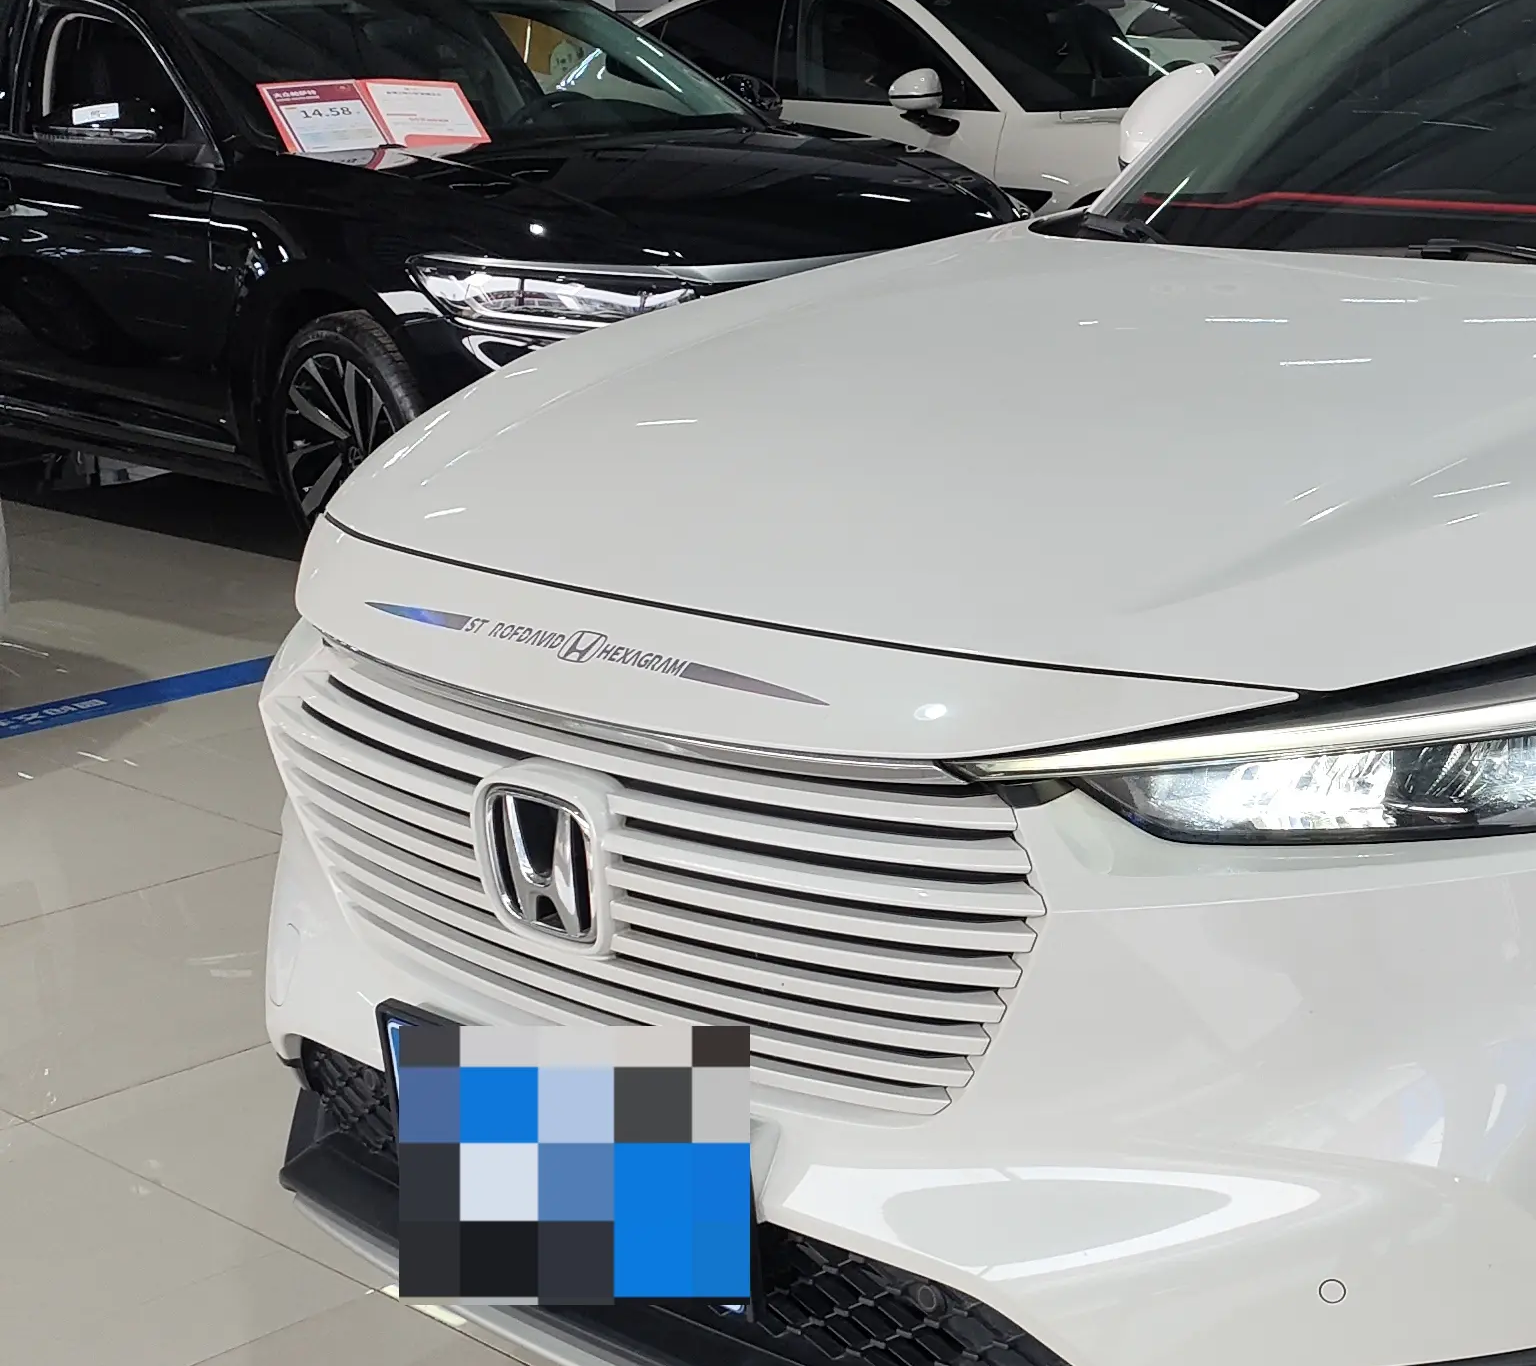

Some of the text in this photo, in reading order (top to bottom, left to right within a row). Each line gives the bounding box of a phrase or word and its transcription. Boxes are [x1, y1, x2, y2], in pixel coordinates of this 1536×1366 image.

[301, 106, 352, 119] 14.58
[464, 616, 490, 634] ST
[599, 644, 686, 677] HEXAGRAM
